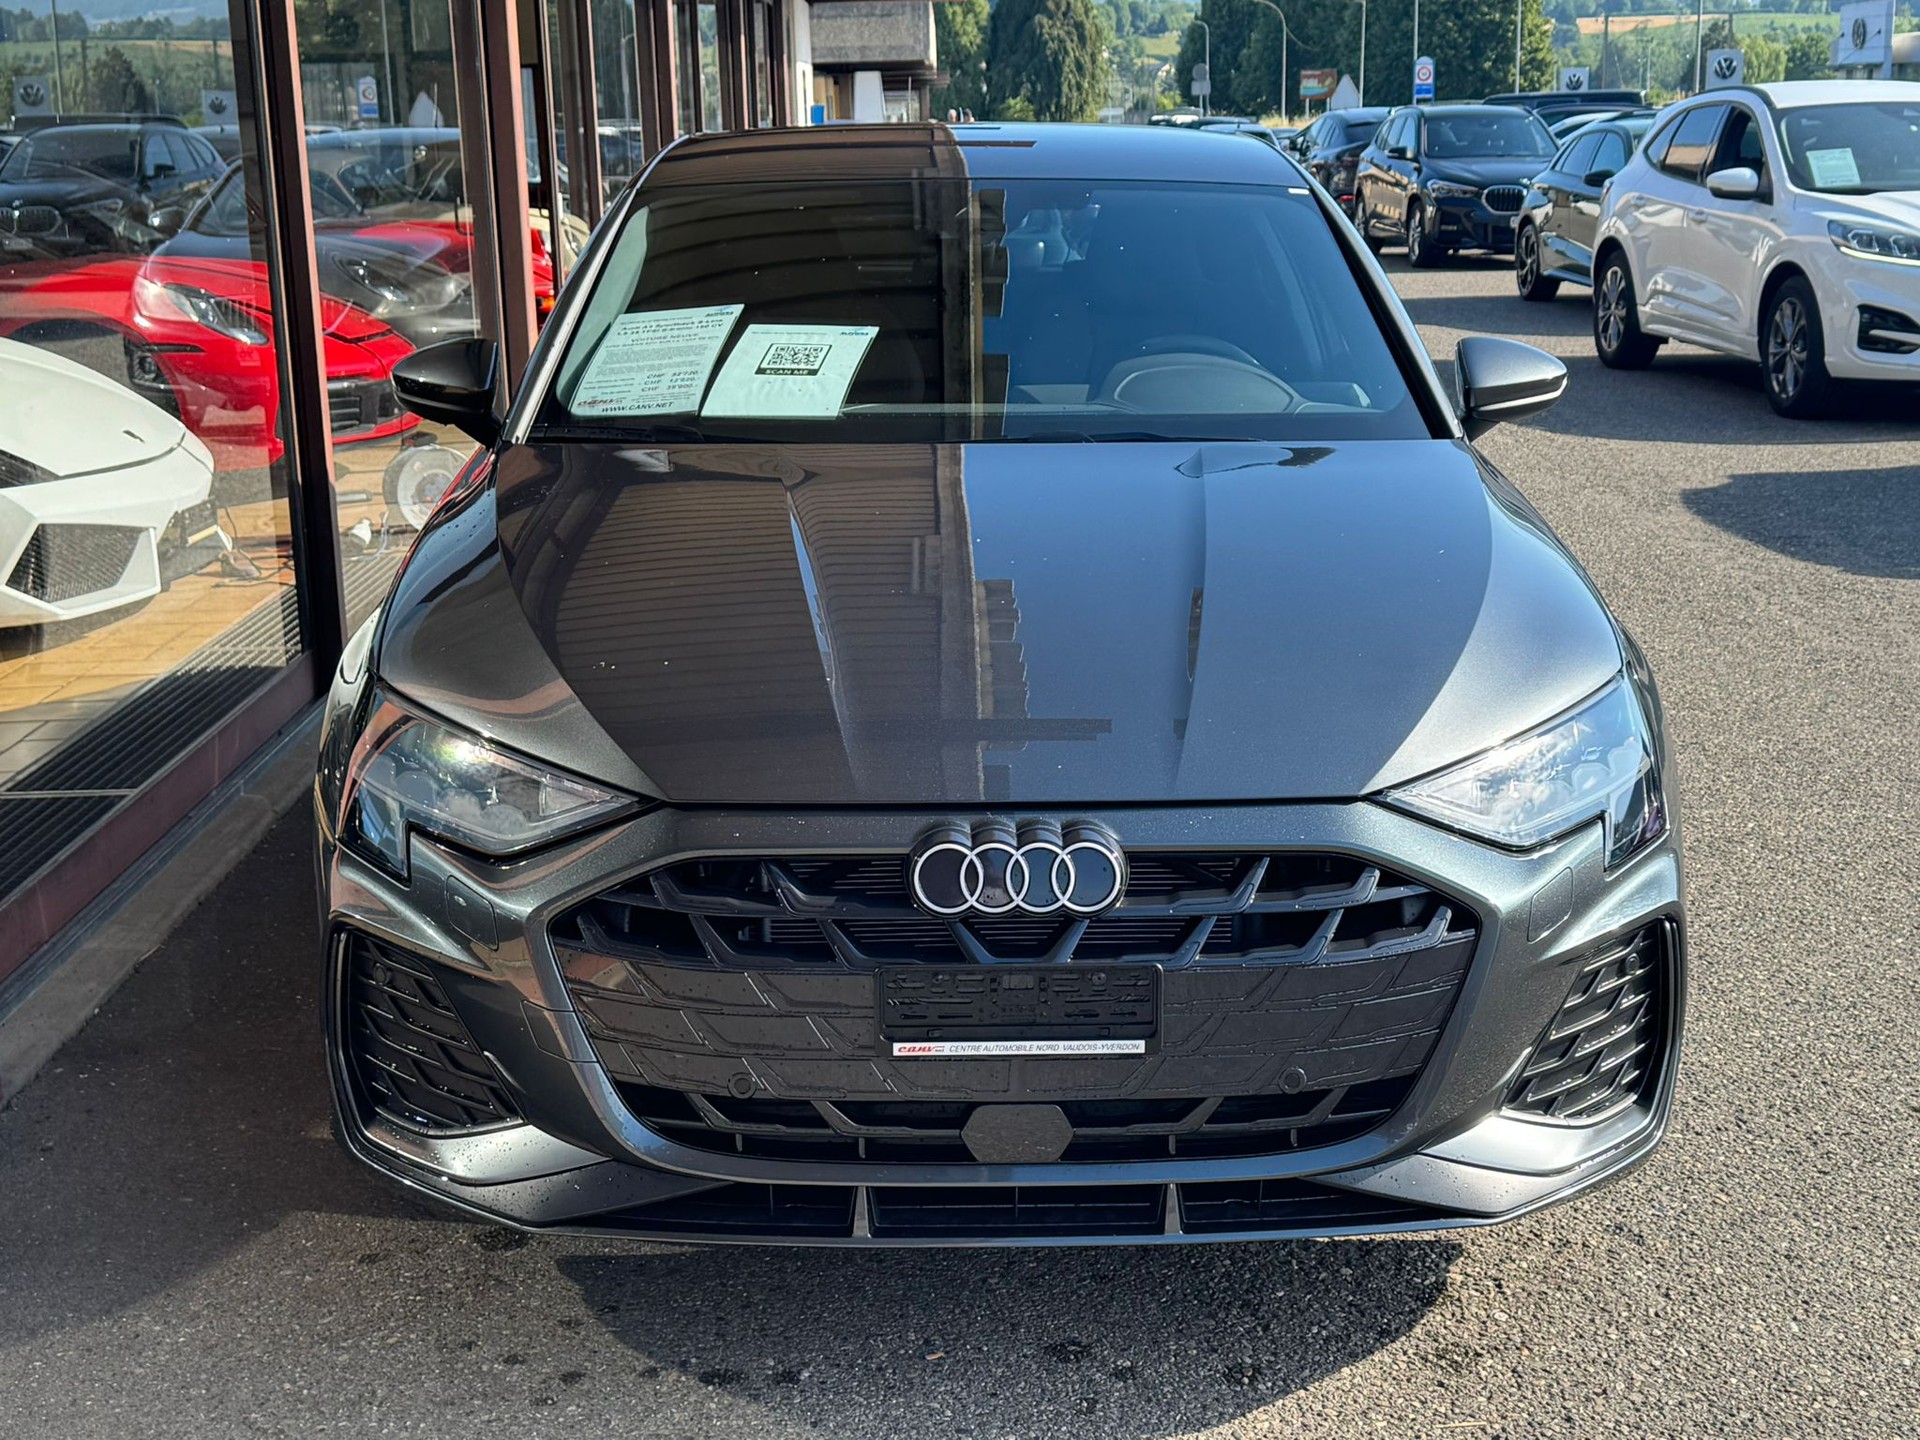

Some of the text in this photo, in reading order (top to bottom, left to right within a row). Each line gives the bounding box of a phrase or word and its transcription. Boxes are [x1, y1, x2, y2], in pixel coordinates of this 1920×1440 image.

[631, 335, 668, 343] VOITURE
[601, 402, 674, 413] WWW.CANV.NET
[949, 1045, 981, 1053] CENTRE
[982, 1044, 1034, 1053] AUTOMOBILE
[1035, 1044, 1059, 1052] NORD
[1063, 1042, 1141, 1051] VAUDOIS-YVERDON
